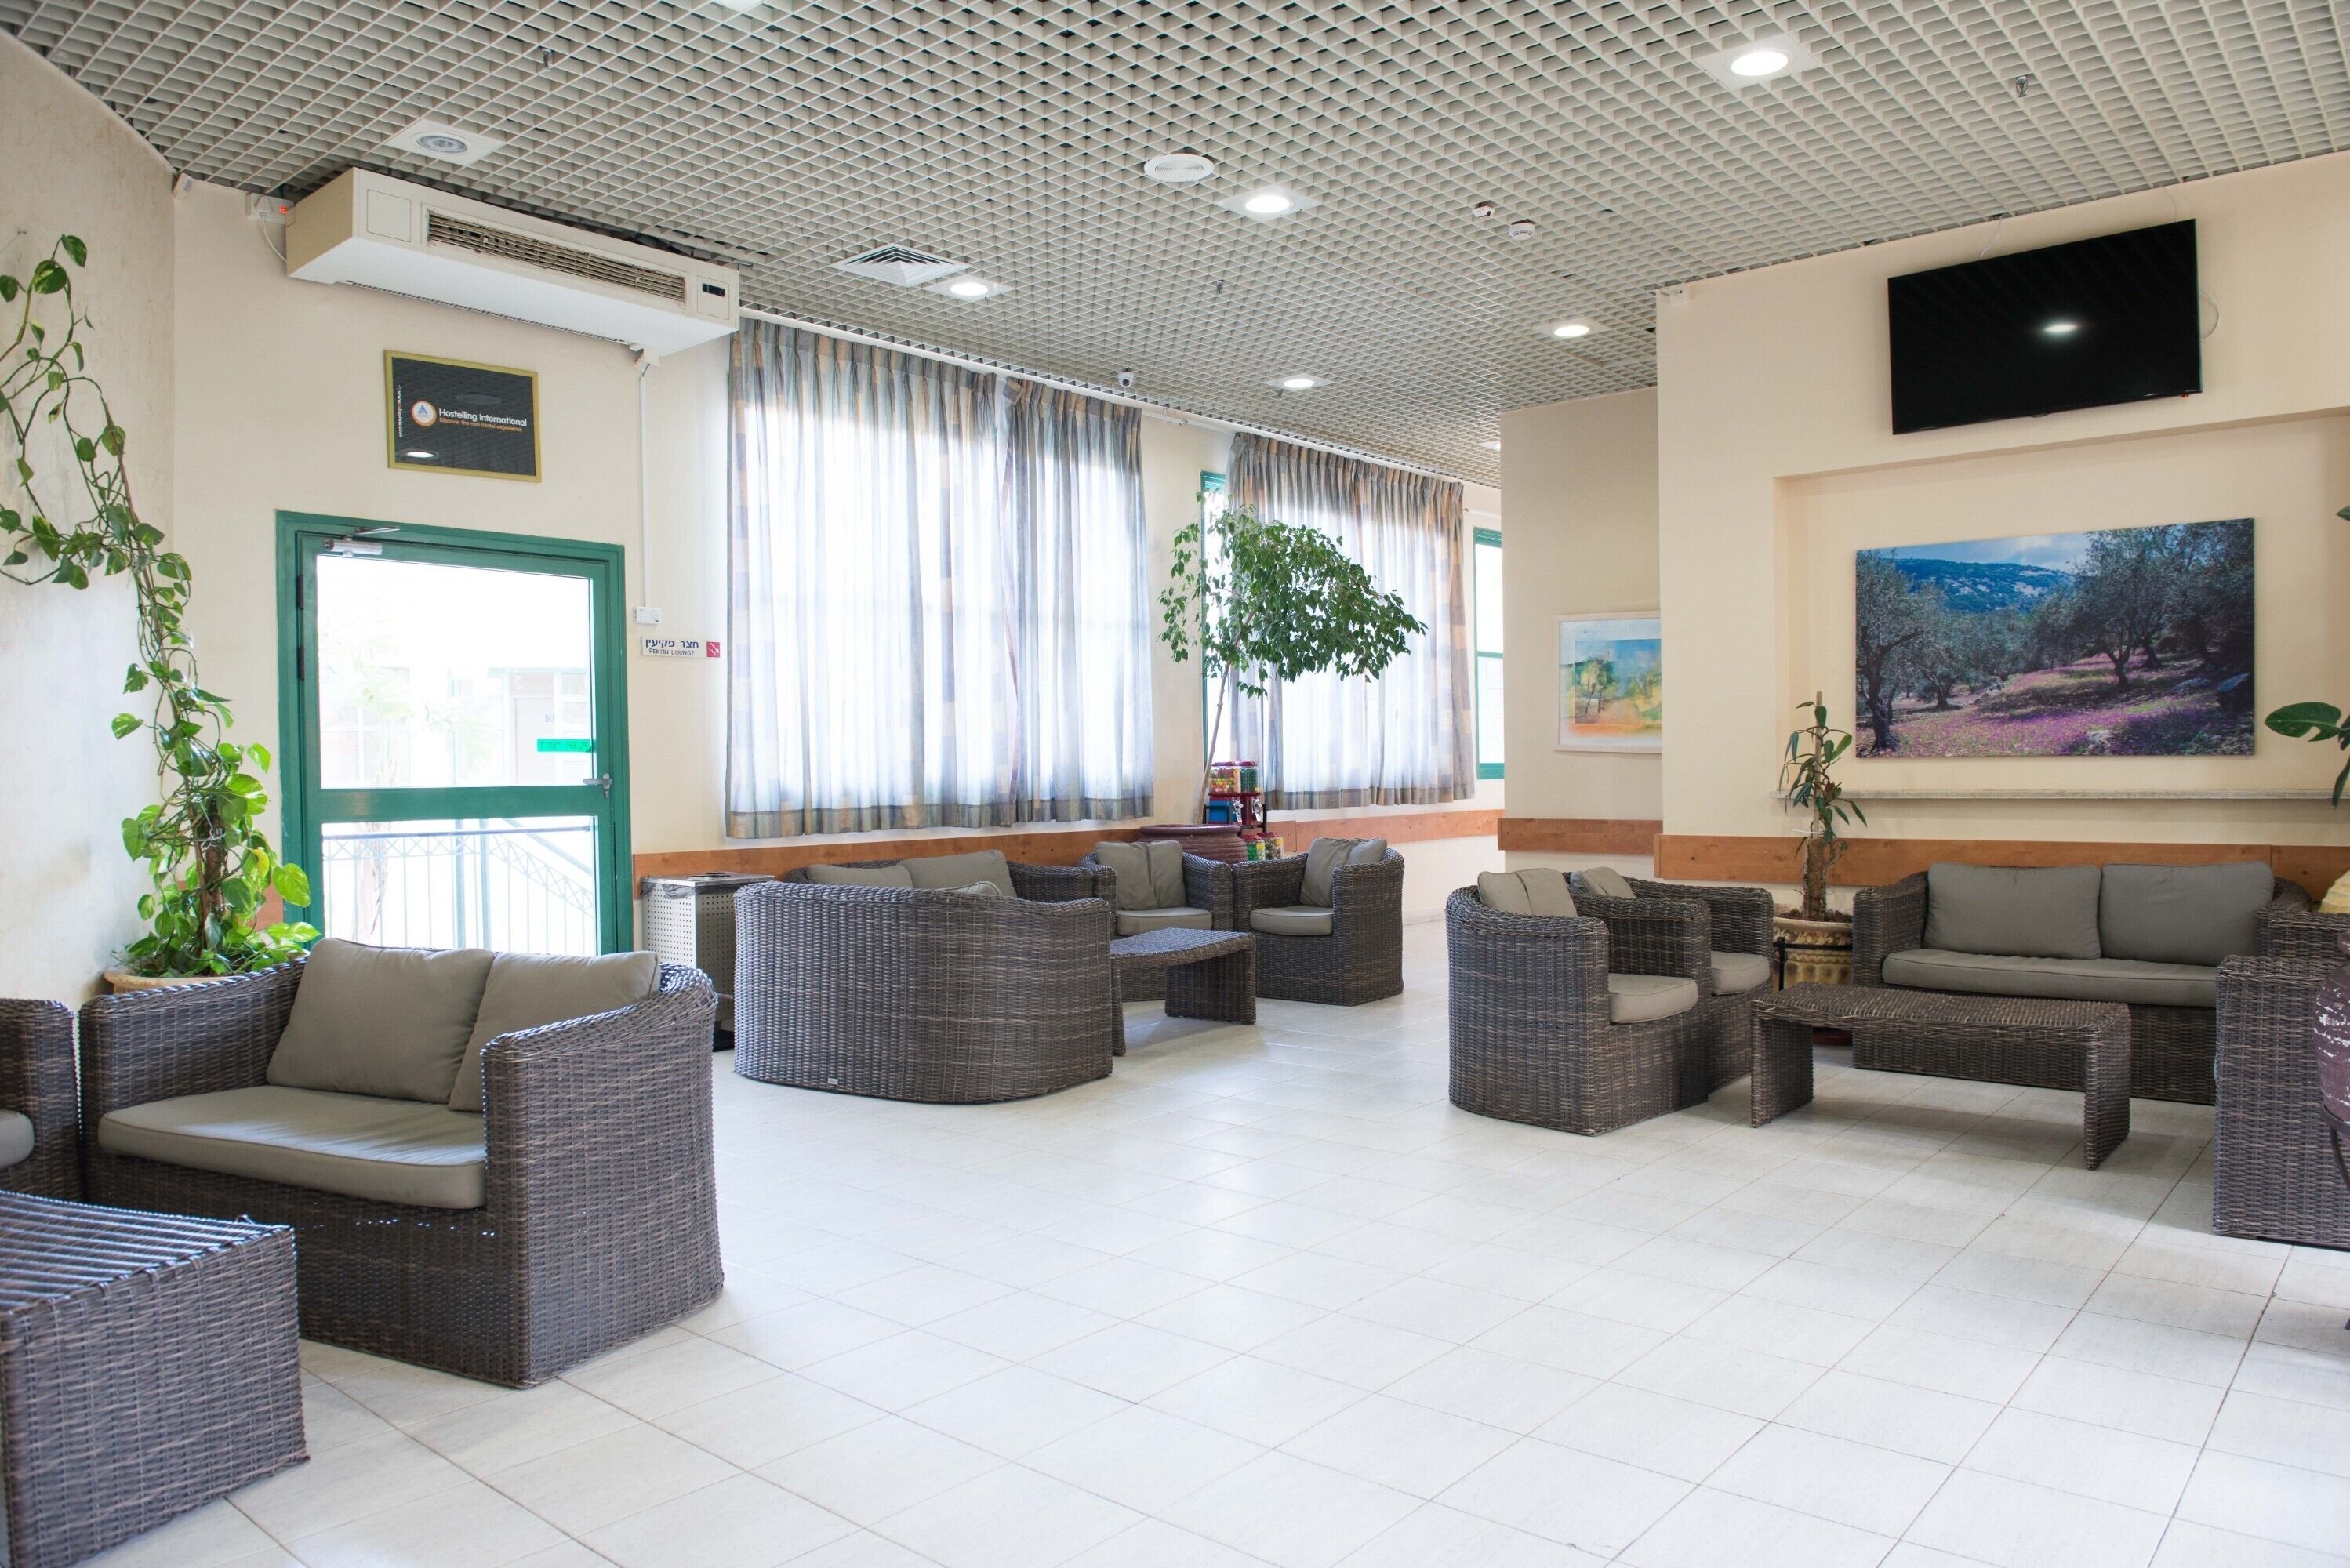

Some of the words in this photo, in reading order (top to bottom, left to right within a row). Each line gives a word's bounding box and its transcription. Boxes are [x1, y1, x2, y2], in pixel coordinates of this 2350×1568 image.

[439, 408, 478, 422] Hostelling
[479, 413, 527, 426] International
[496, 424, 523, 433] experience
[645, 639, 675, 648] פקיעין
